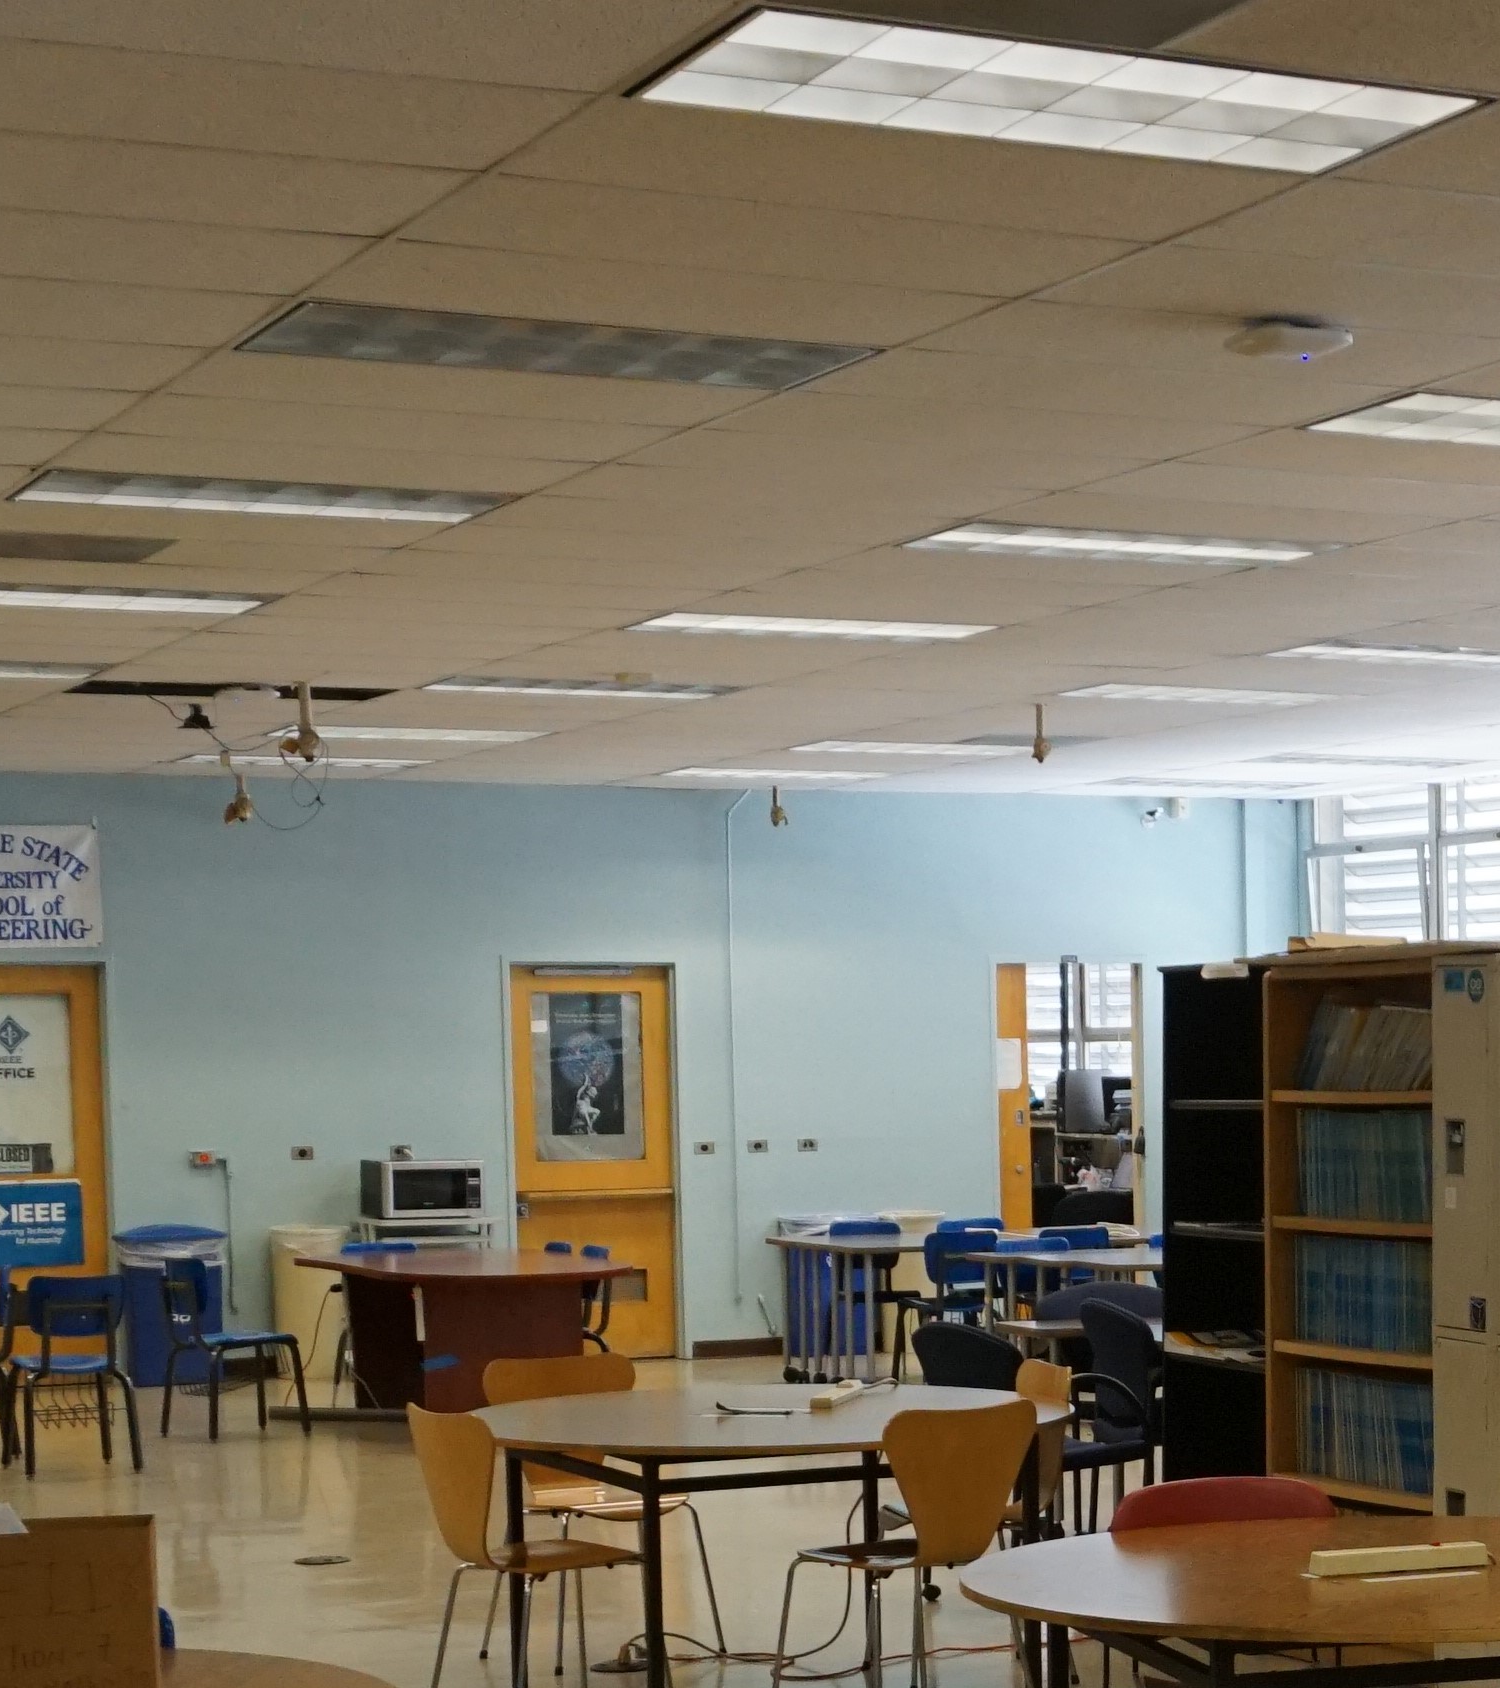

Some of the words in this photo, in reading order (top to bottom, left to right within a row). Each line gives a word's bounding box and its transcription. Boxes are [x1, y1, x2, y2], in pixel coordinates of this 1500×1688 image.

[21, 836, 90, 882] STATE
[42, 894, 66, 916] of
[10, 1202, 67, 1223] IEEE
